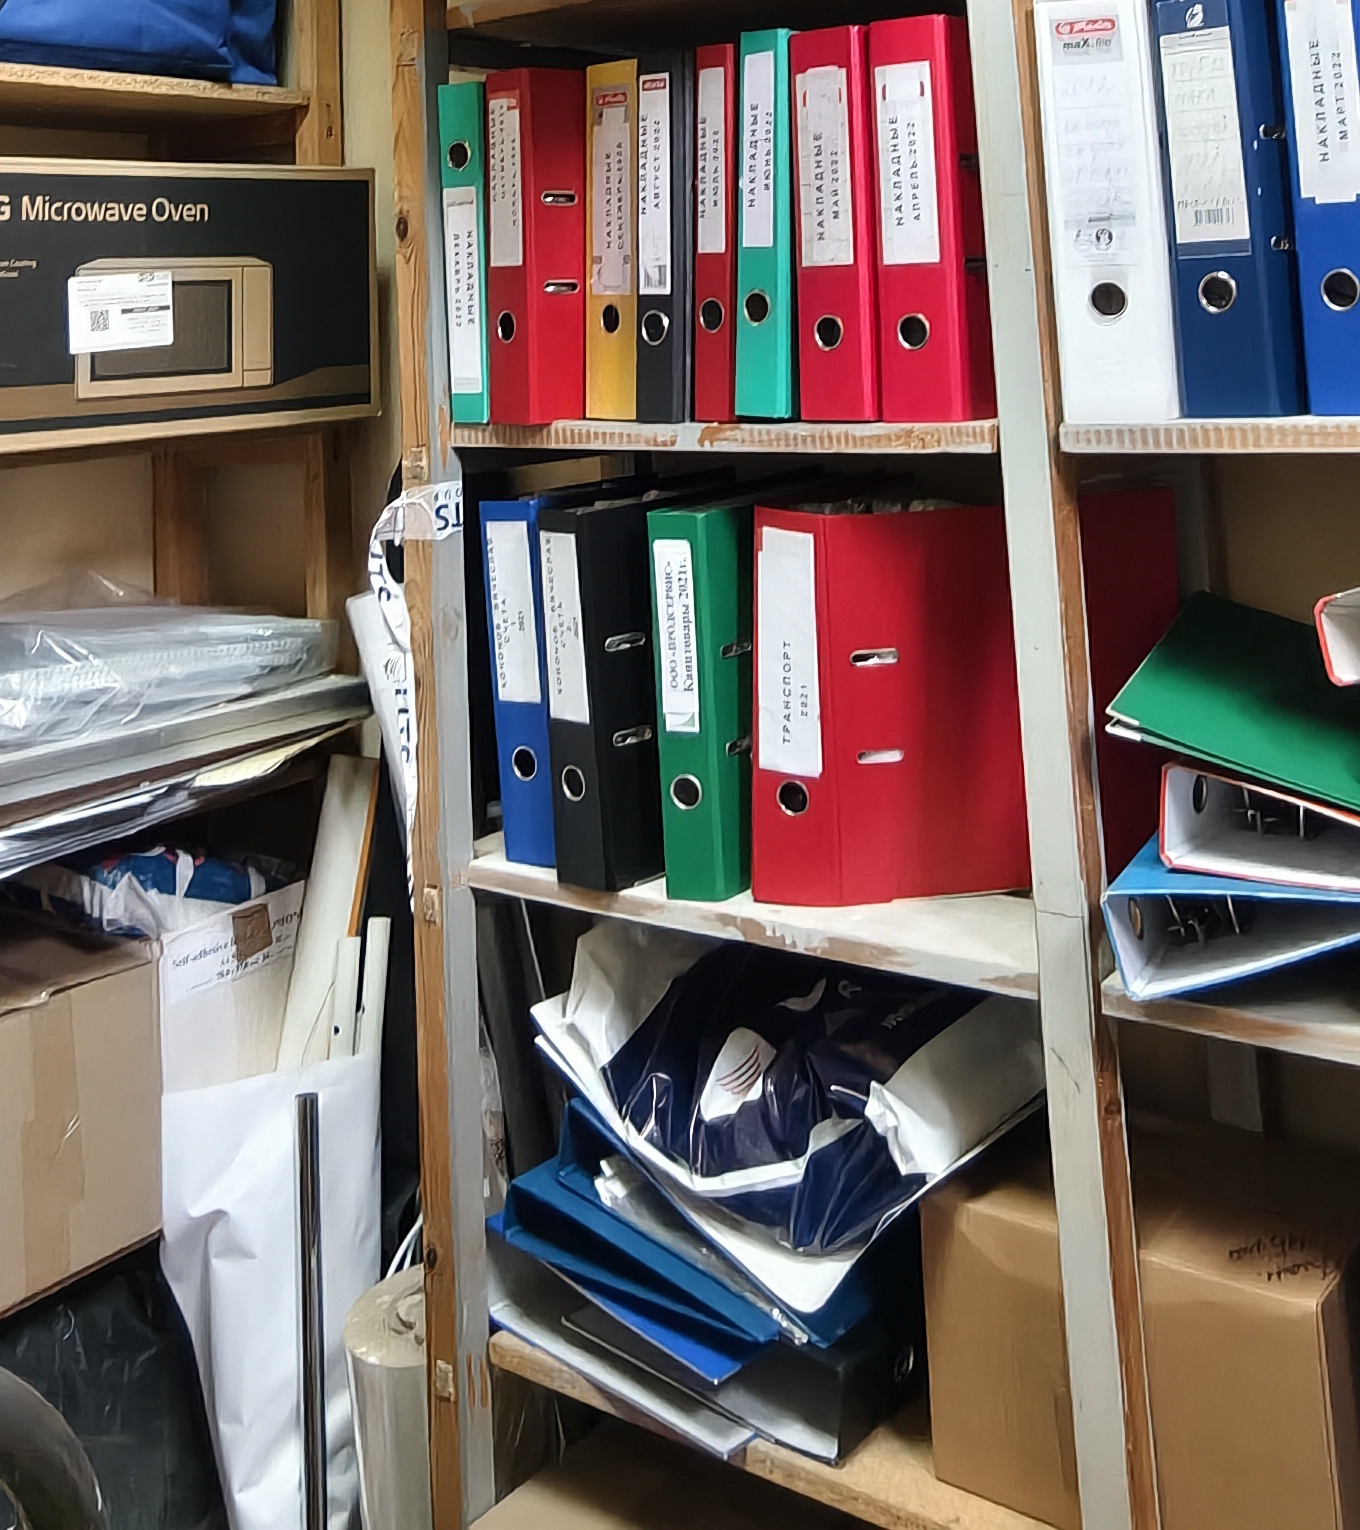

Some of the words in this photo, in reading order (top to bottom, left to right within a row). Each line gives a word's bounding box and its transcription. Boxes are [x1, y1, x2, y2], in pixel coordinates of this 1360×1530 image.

[1309, 39, 1330, 162] НАКЛАДНЫЕ
[1331, 52, 1346, 89] 2022
[748, 103, 759, 208] НАКЛАДНЫЕ
[1335, 95, 1349, 141] МАРТ
[21, 194, 147, 222] Microwave
[151, 196, 209, 223] Oven
[813, 132, 826, 241] НАКЛАДНЫЕ
[889, 115, 905, 227] НАКЛАДНЫЕ
[909, 159, 921, 221] АПРЕЛЬ
[668, 659, 678, 690] ООО
[782, 641, 791, 745] ТРАНСПОРТ
